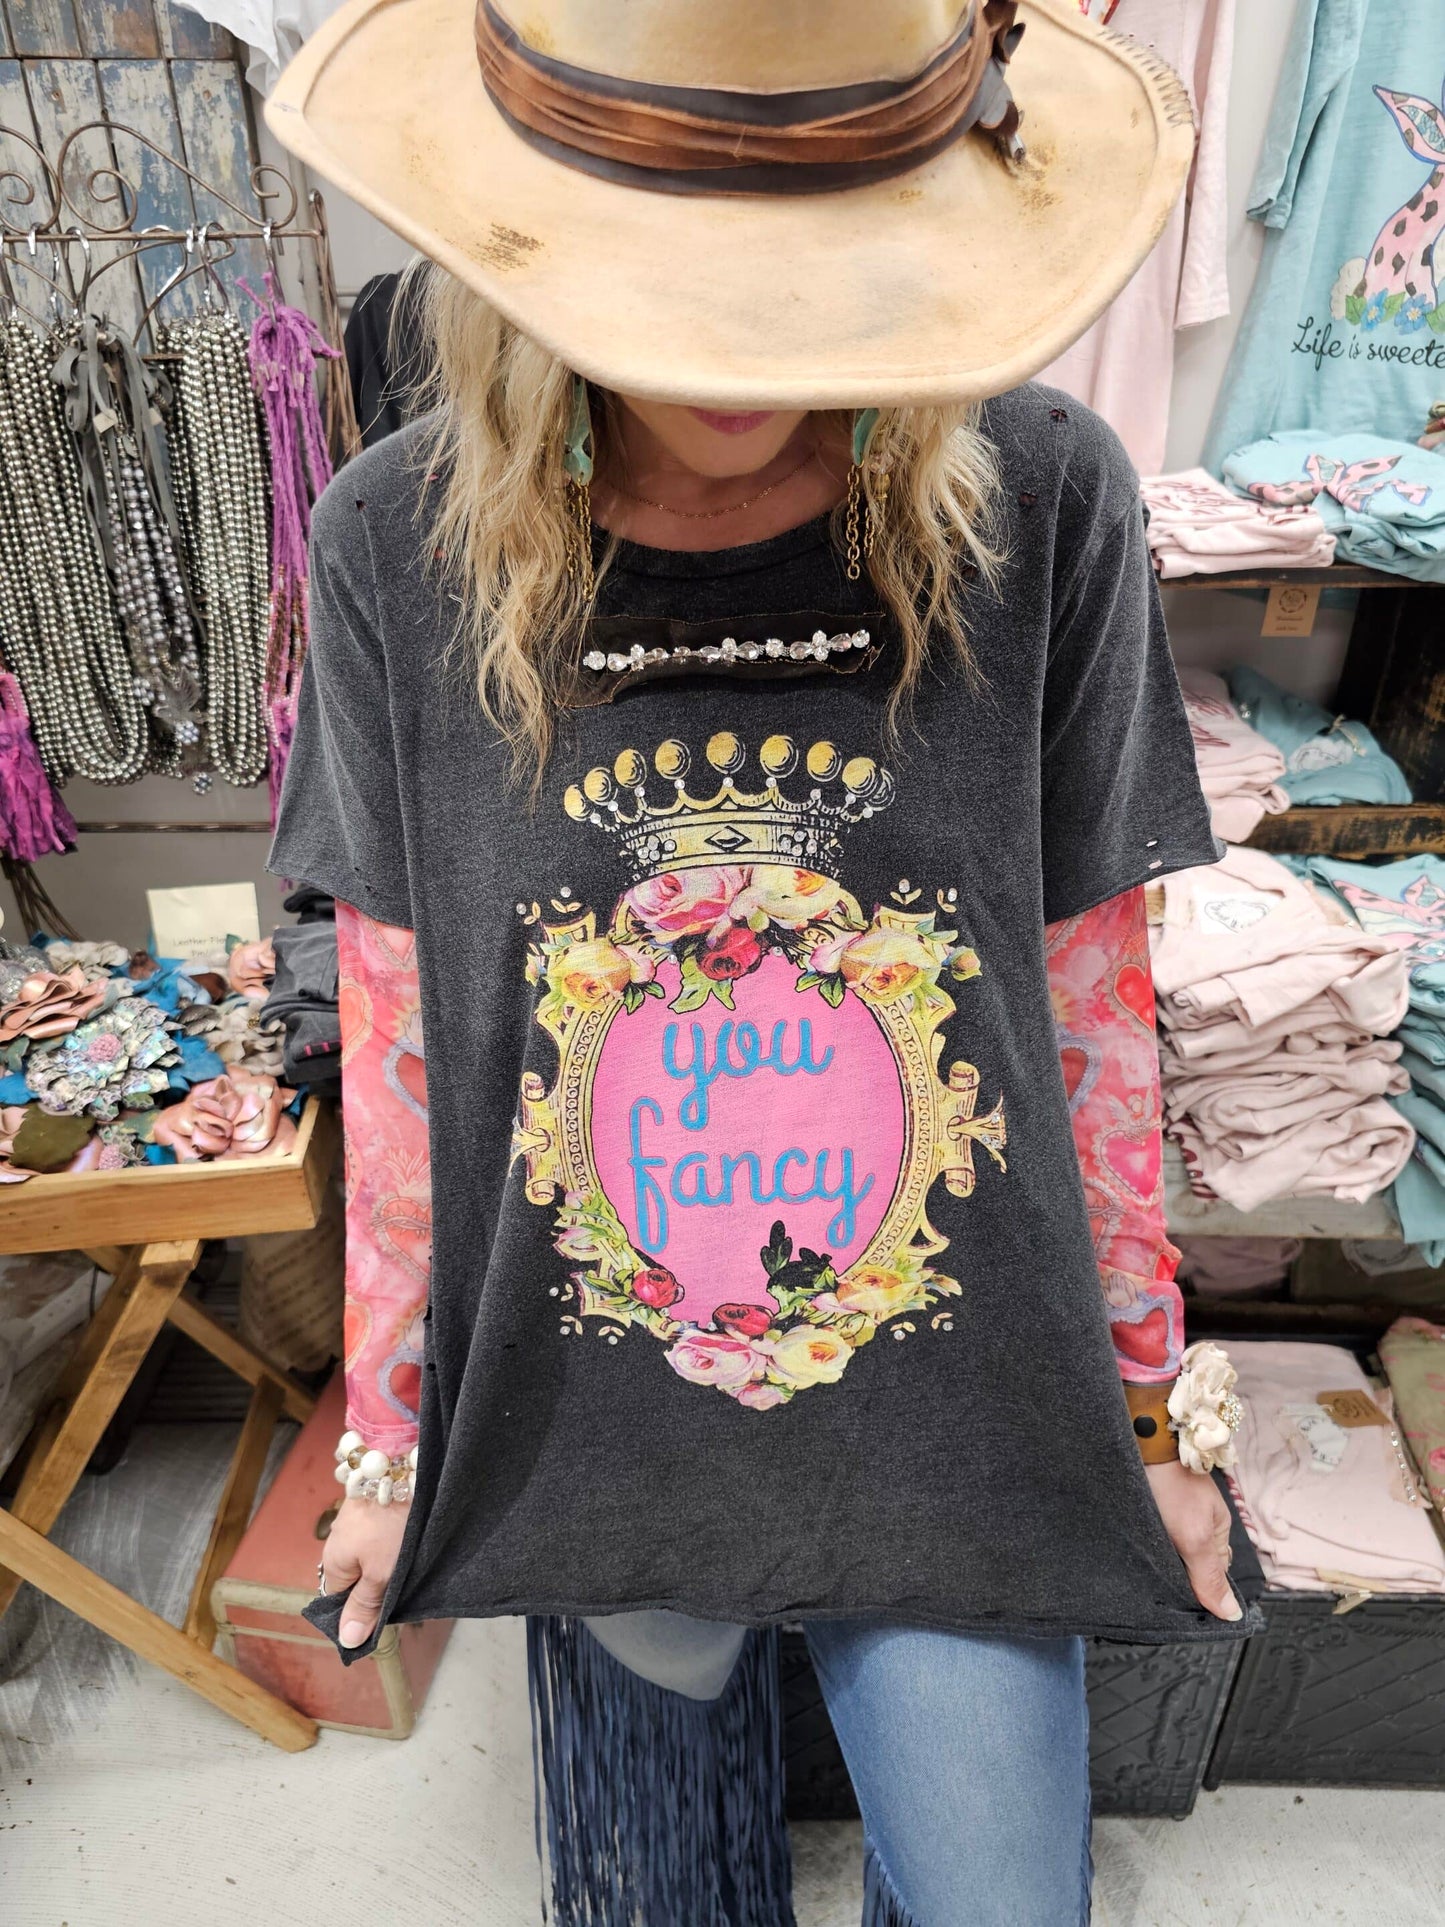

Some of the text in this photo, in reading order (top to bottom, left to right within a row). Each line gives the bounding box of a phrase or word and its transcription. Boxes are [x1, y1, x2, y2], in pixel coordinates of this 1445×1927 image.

[1291, 316, 1345, 371] Life
[1349, 334, 1362, 360] is
[662, 1018, 835, 1131] you
[628, 1096, 875, 1254] fancy
